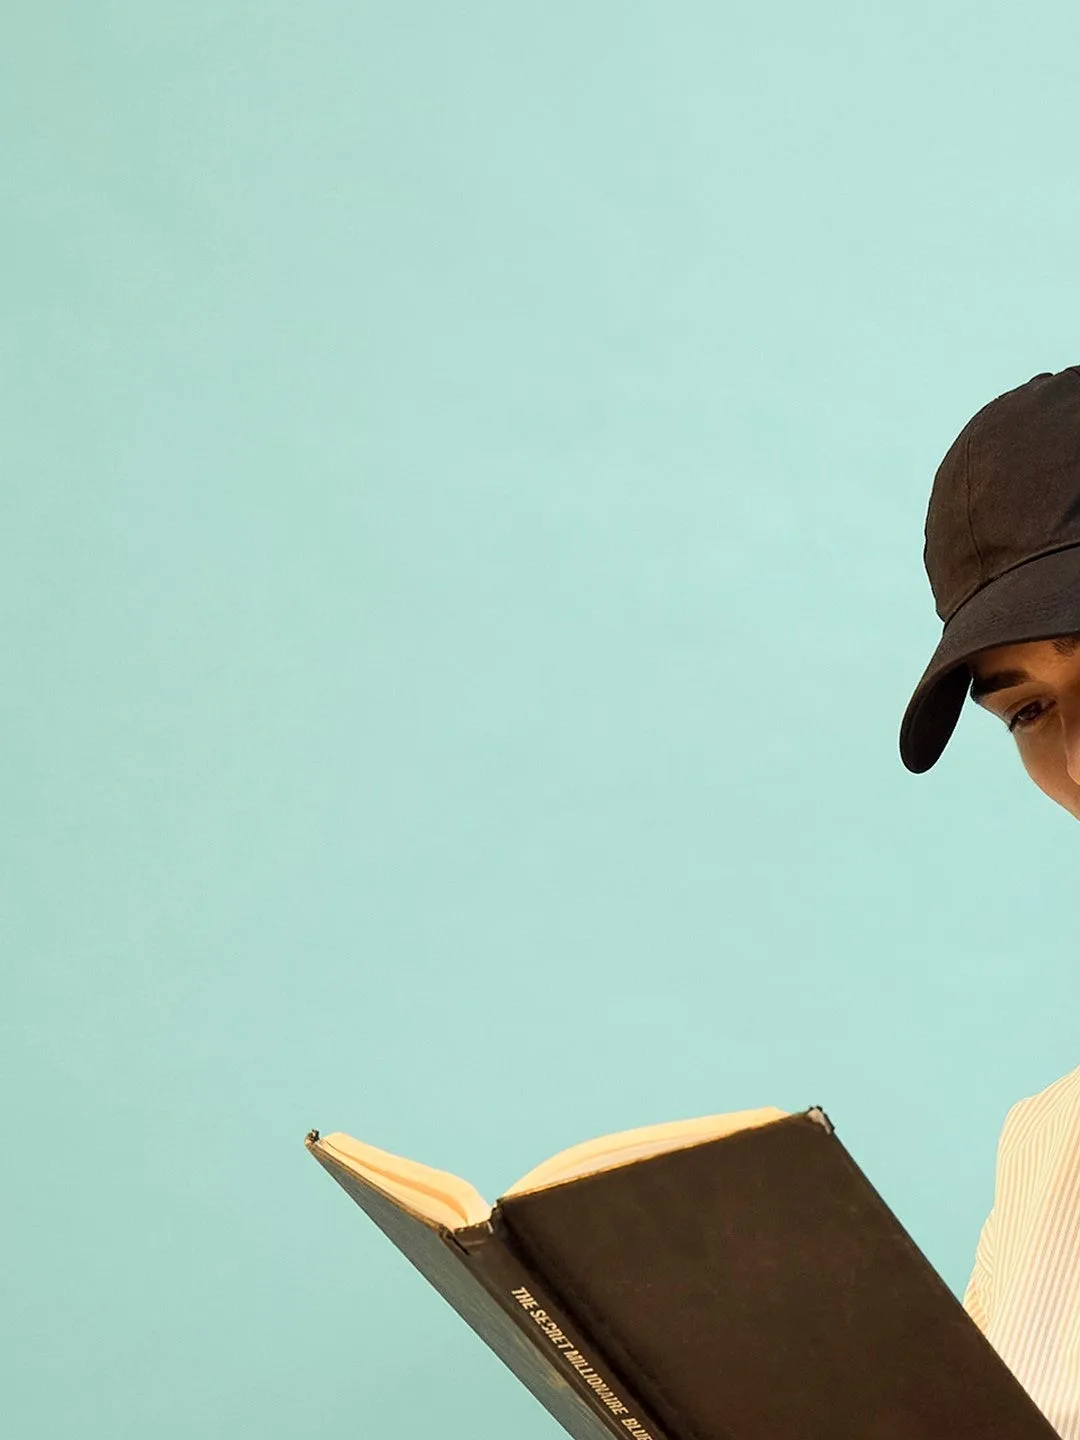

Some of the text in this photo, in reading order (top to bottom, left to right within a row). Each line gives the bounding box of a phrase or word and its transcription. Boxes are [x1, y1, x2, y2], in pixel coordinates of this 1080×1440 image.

[511, 1286, 539, 1310] THE
[529, 1309, 574, 1349] SECRET
[563, 1350, 629, 1415] MILLIONAIRE
